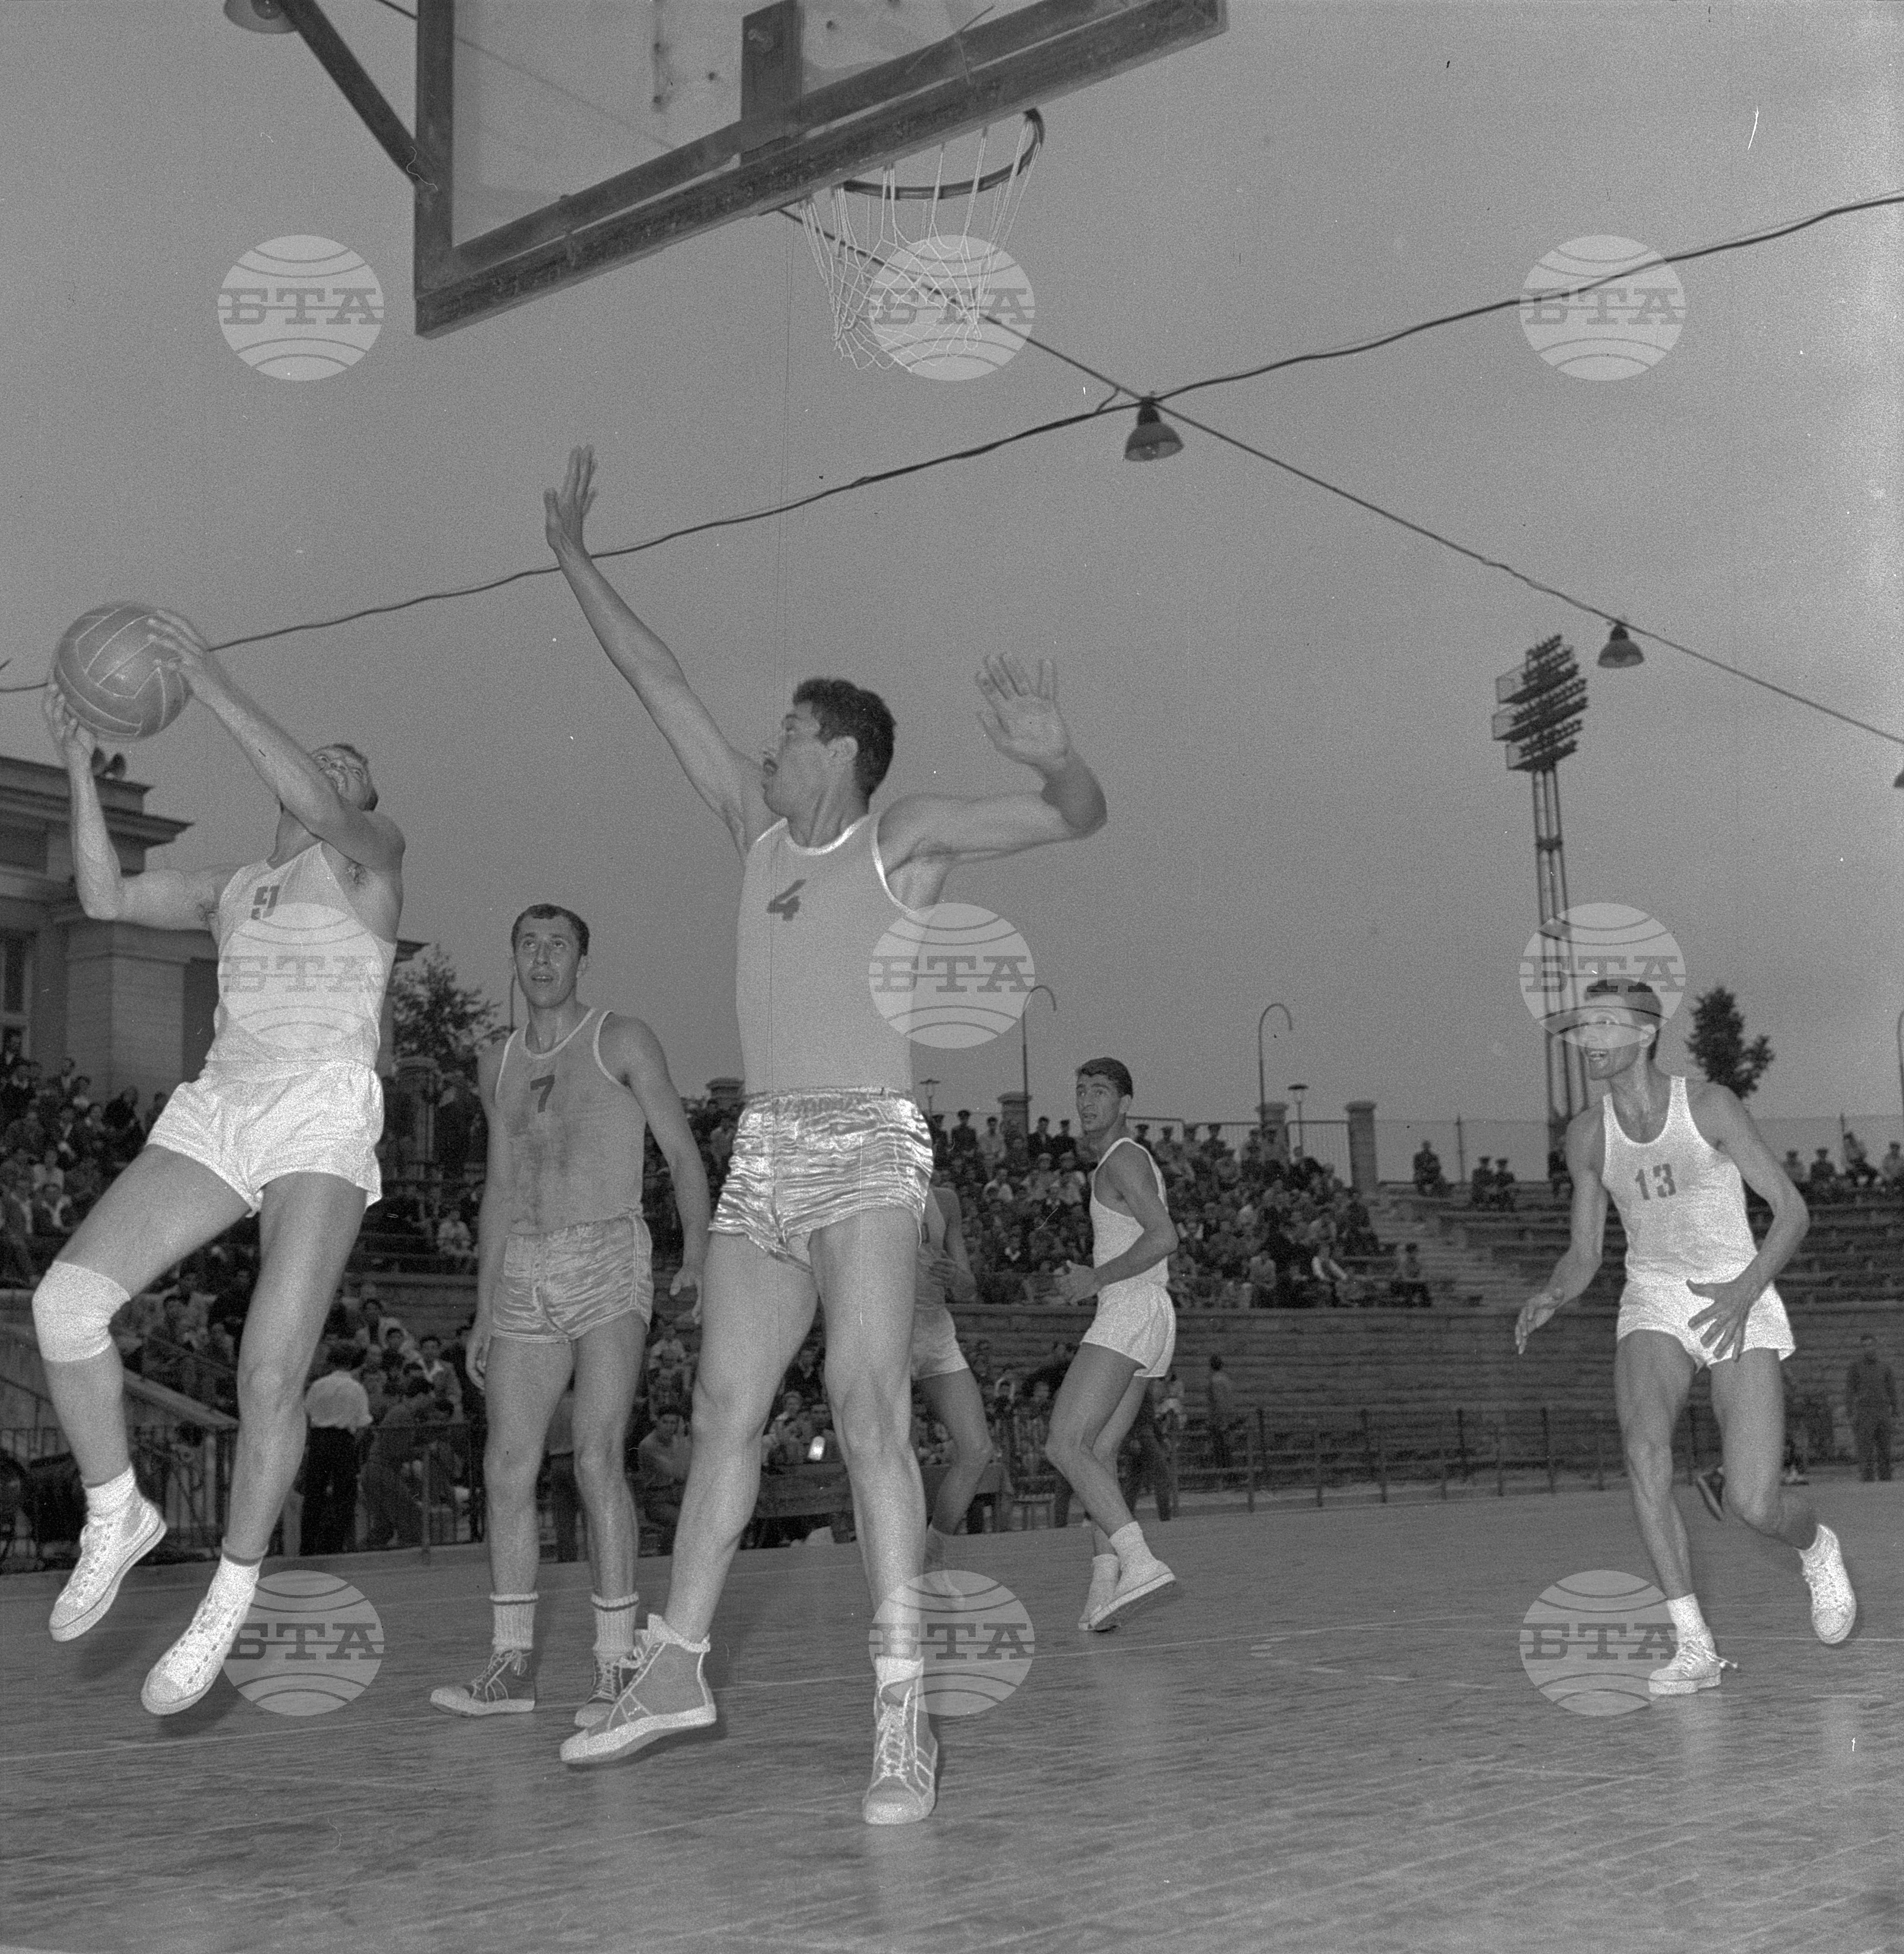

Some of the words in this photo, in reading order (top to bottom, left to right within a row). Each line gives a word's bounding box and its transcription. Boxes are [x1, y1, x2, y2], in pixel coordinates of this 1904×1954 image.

[767, 879, 806, 922] 4
[530, 1075, 555, 1113] 7
[1635, 1163, 1676, 1200] 13
